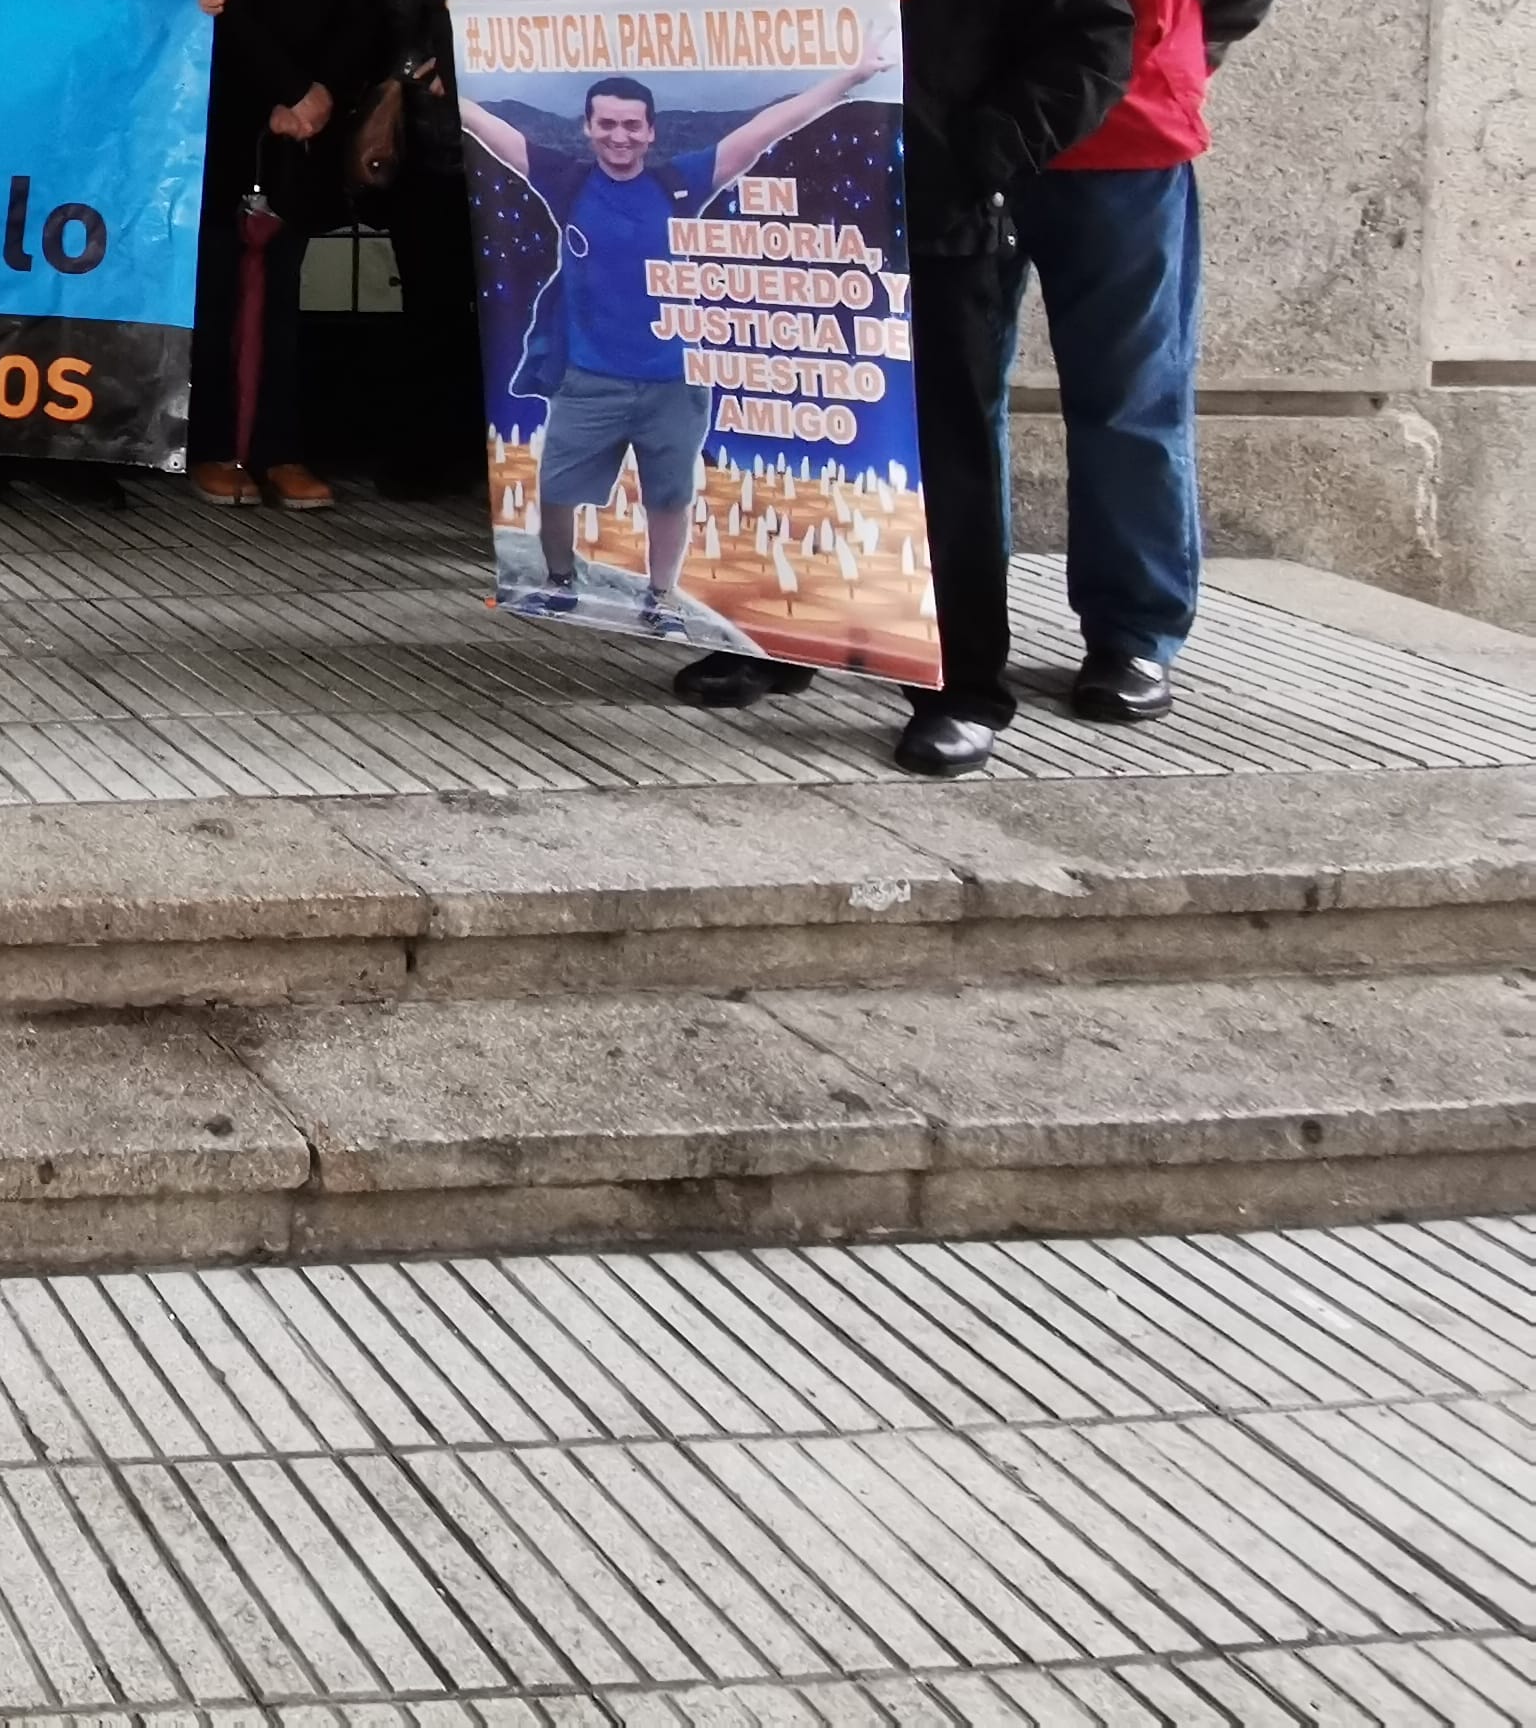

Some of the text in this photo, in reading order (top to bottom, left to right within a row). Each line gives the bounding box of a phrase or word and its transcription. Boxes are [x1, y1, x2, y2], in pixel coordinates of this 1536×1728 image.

[465, 6, 862, 69] #JUSTICIA PARA MARCELO
[740, 178, 797, 214] EN
[669, 219, 881, 272] MEMORIA,
[647, 261, 909, 312] RECUERDO Y
[651, 304, 910, 359] JUSTICIA DE
[684, 349, 884, 401] NUESTRO
[716, 396, 856, 443] AMIGO
